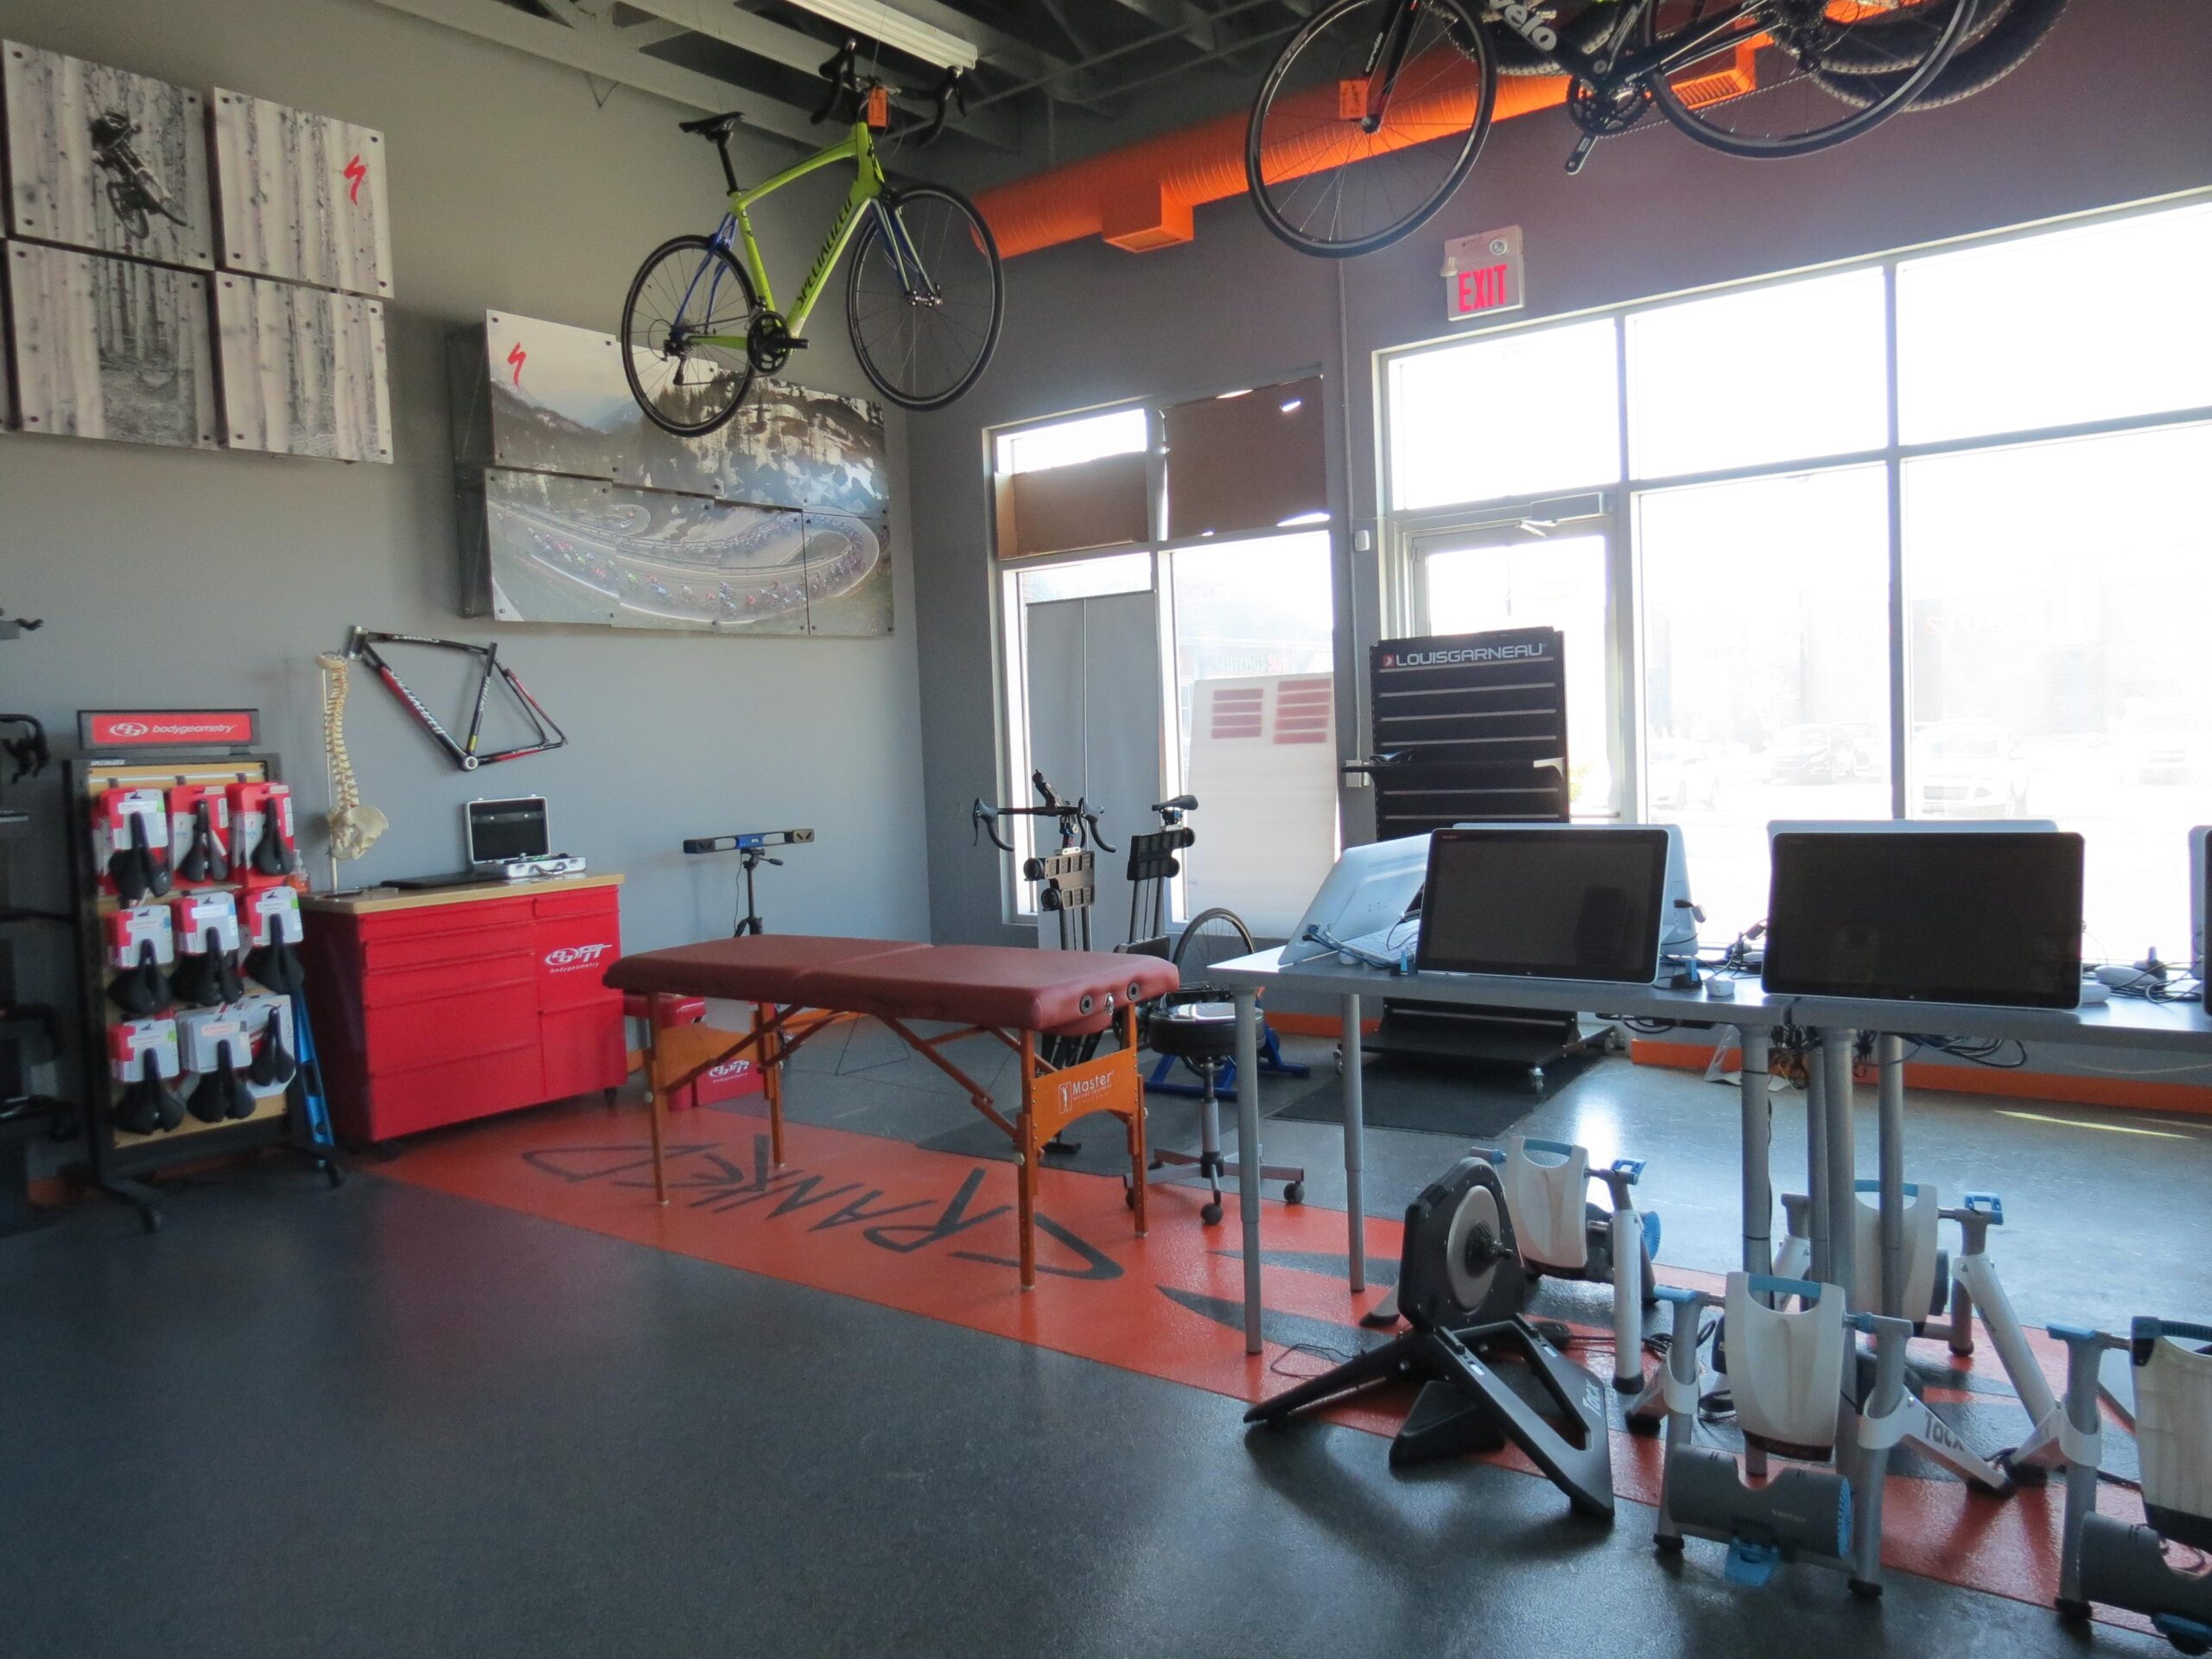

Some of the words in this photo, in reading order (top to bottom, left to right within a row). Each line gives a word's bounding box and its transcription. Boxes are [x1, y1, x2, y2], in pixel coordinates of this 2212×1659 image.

[1458, 263, 1508, 313] EXIT
[1395, 643, 1543, 667] LOUISGARNEAU
[152, 725, 235, 734] bodygeometry
[1072, 1071, 1114, 1096] Master
[520, 1134, 1124, 1282] CRANKED
[1924, 1408, 1965, 1452] Tacx
